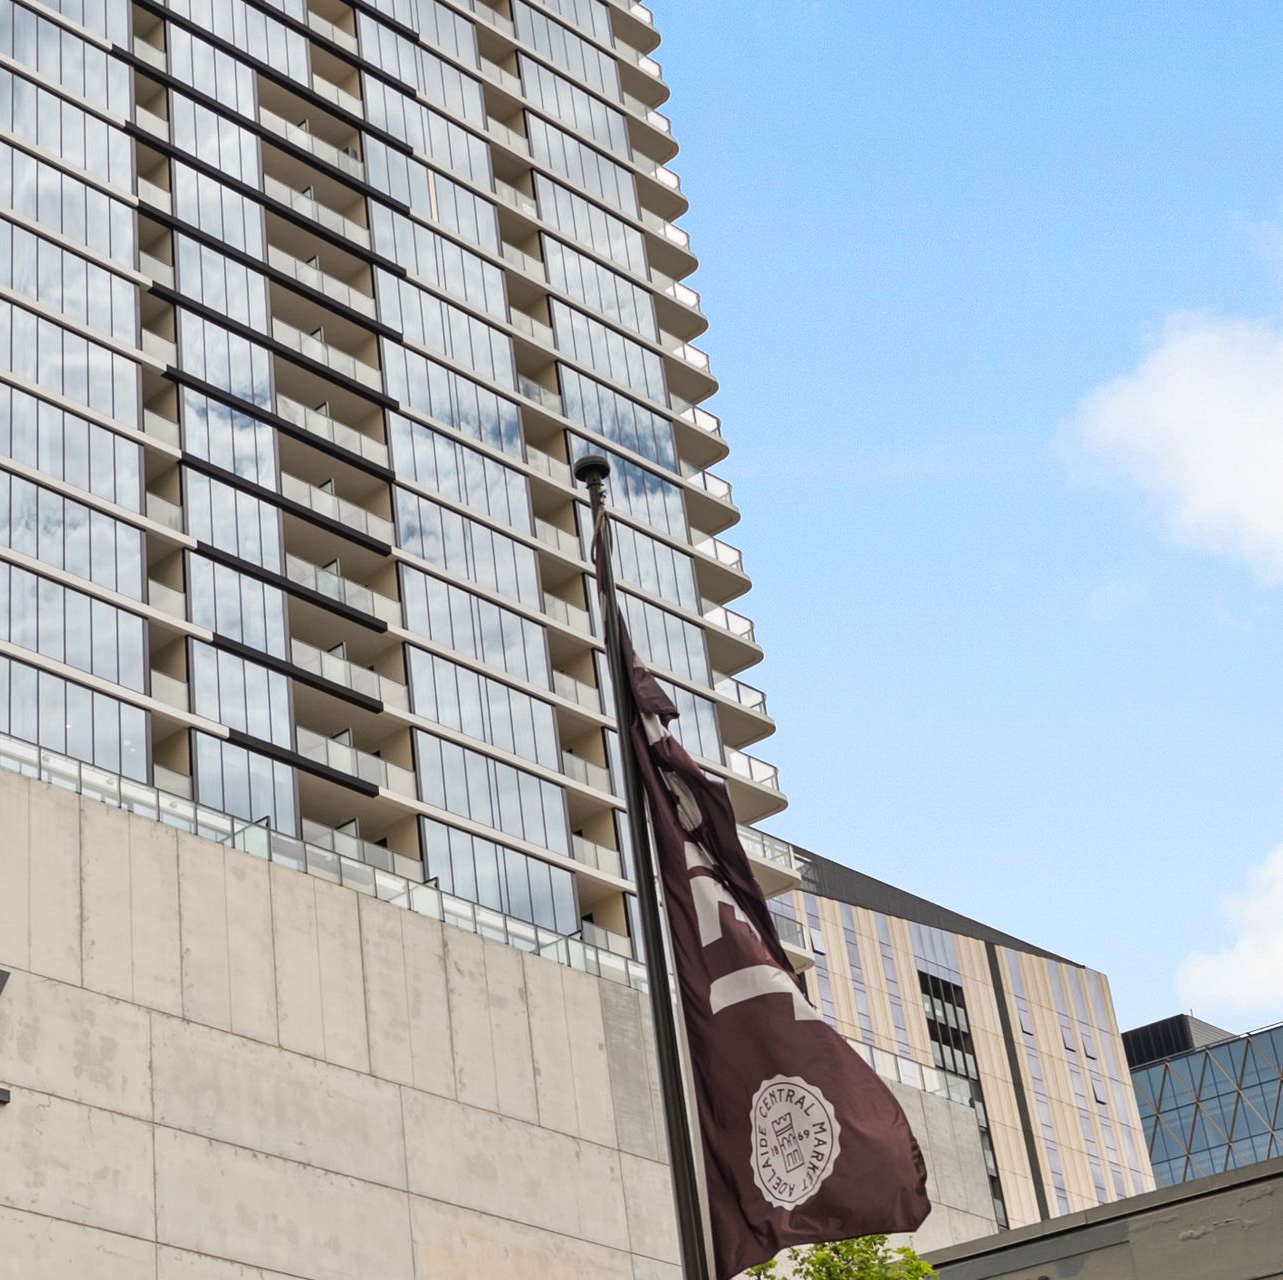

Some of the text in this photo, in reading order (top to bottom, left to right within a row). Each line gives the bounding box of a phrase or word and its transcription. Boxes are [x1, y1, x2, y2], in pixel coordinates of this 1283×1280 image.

[758, 1088, 828, 1197] ADELAIDE CENTRAL MARKET
